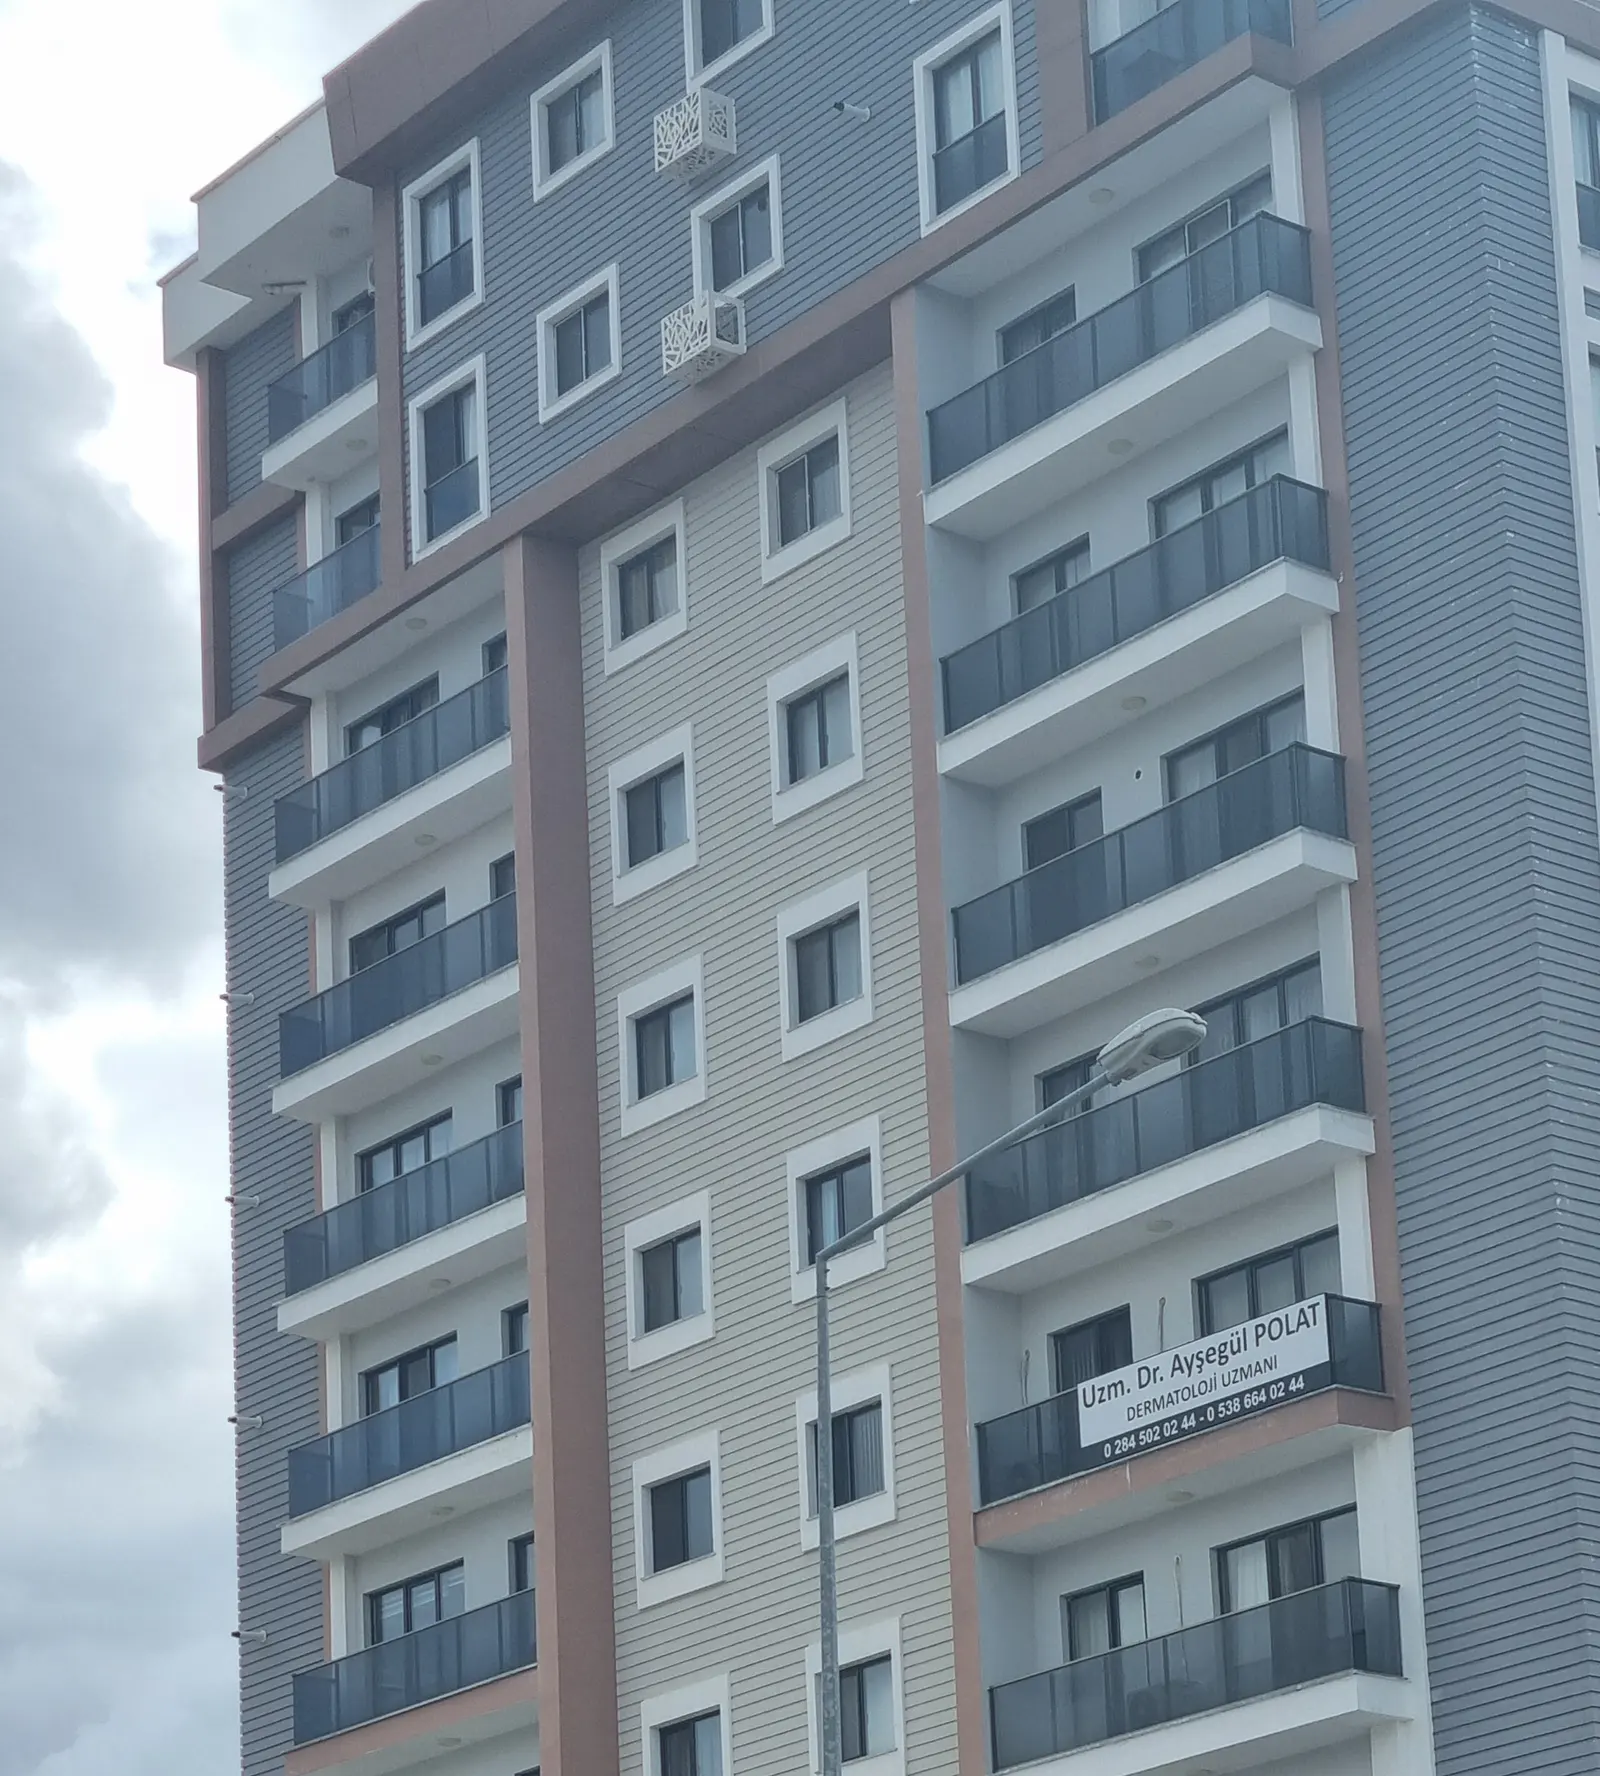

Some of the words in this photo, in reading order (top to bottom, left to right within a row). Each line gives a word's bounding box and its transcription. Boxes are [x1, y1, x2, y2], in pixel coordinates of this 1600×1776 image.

[1082, 1382, 1131, 1409] Uzm.
[1137, 1366, 1164, 1390] Dr.
[1171, 1328, 1248, 1373] Ayşegül
[1255, 1302, 1321, 1347] POLAT
[1126, 1372, 1218, 1422] DERMATOLOJİ
[1221, 1355, 1278, 1388] UZMANI
[1104, 1443, 1111, 1458] 0
[1115, 1435, 1136, 1454] 284
[1139, 1428, 1160, 1447] 502
[1164, 1420, 1178, 1436] 02
[1181, 1416, 1196, 1430] 44
[1207, 1407, 1214, 1422] 0
[1218, 1400, 1241, 1418] 538
[1244, 1391, 1266, 1409] 664
[1270, 1383, 1285, 1399] 02
[1288, 1375, 1304, 1391] 44
